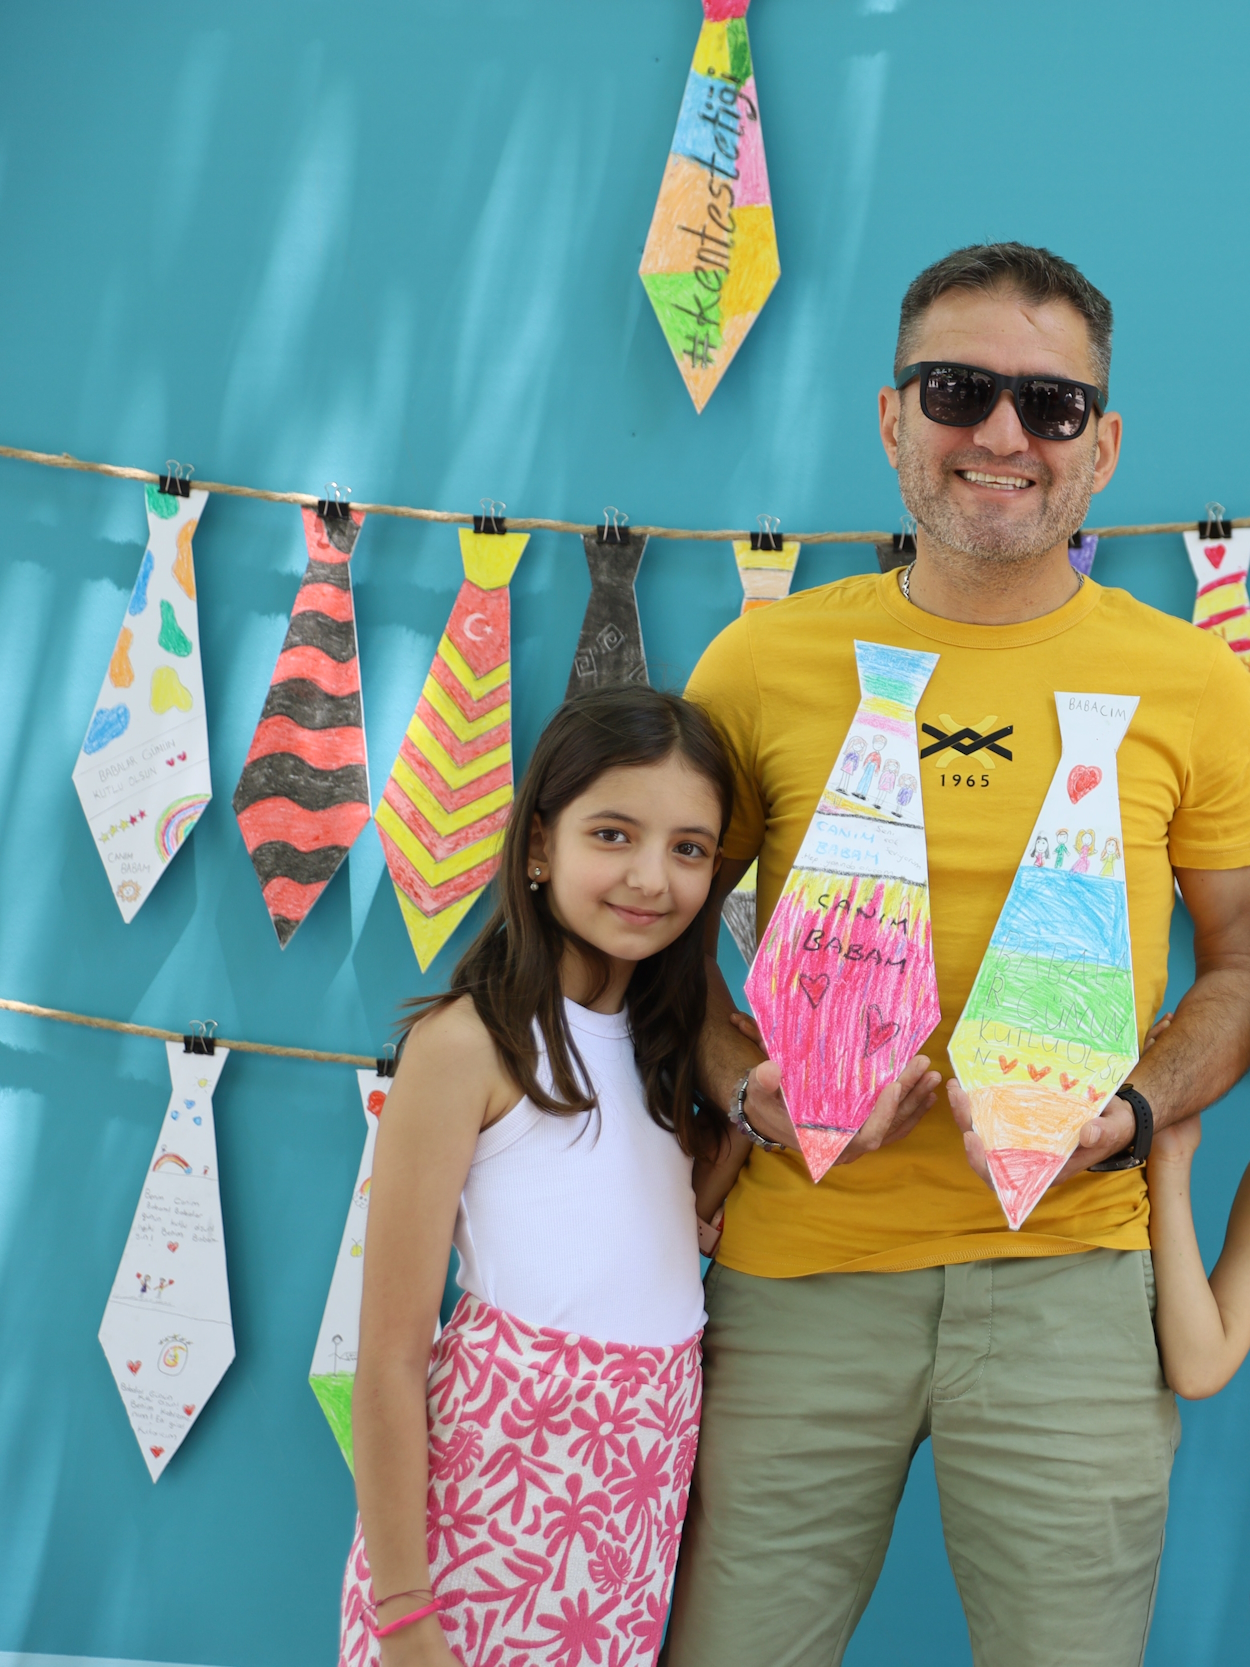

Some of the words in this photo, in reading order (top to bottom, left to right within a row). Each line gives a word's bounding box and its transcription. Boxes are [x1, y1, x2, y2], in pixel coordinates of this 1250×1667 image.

[1069, 697, 1126, 721] BABACIM
[98, 756, 138, 782] BABALAR
[940, 774, 989, 787] 1965
[92, 782, 124, 799] KUTLU
[128, 766, 157, 787] OLSUN
[815, 841, 879, 865] BABAM
[121, 862, 151, 874] BABAM
[818, 894, 907, 935] CANIM
[803, 928, 907, 974] BABAM
